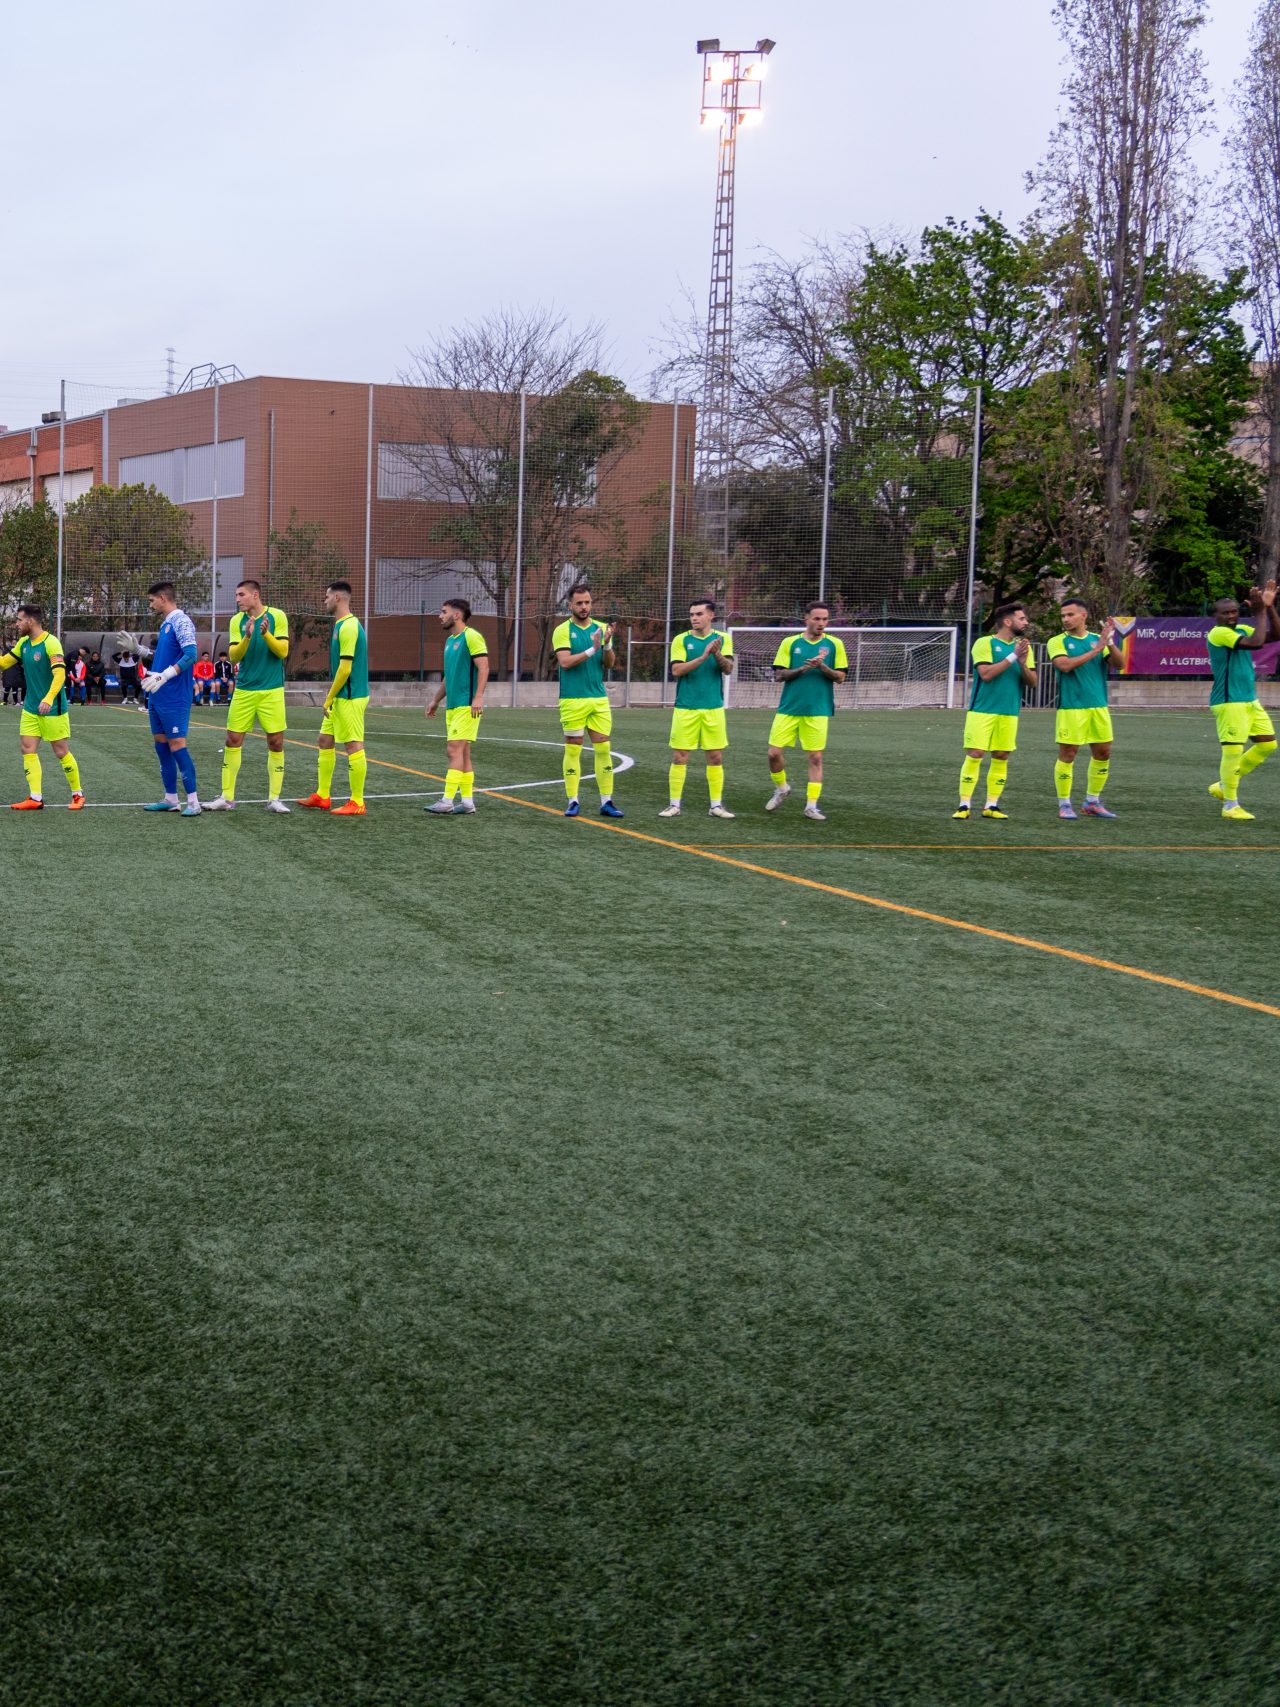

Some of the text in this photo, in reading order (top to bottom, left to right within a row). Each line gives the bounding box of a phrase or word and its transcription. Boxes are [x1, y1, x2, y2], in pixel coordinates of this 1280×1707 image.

[1137, 629, 1157, 640] MiR,
[1160, 628, 1202, 640] orgullosa
[1160, 658, 1167, 666] A
